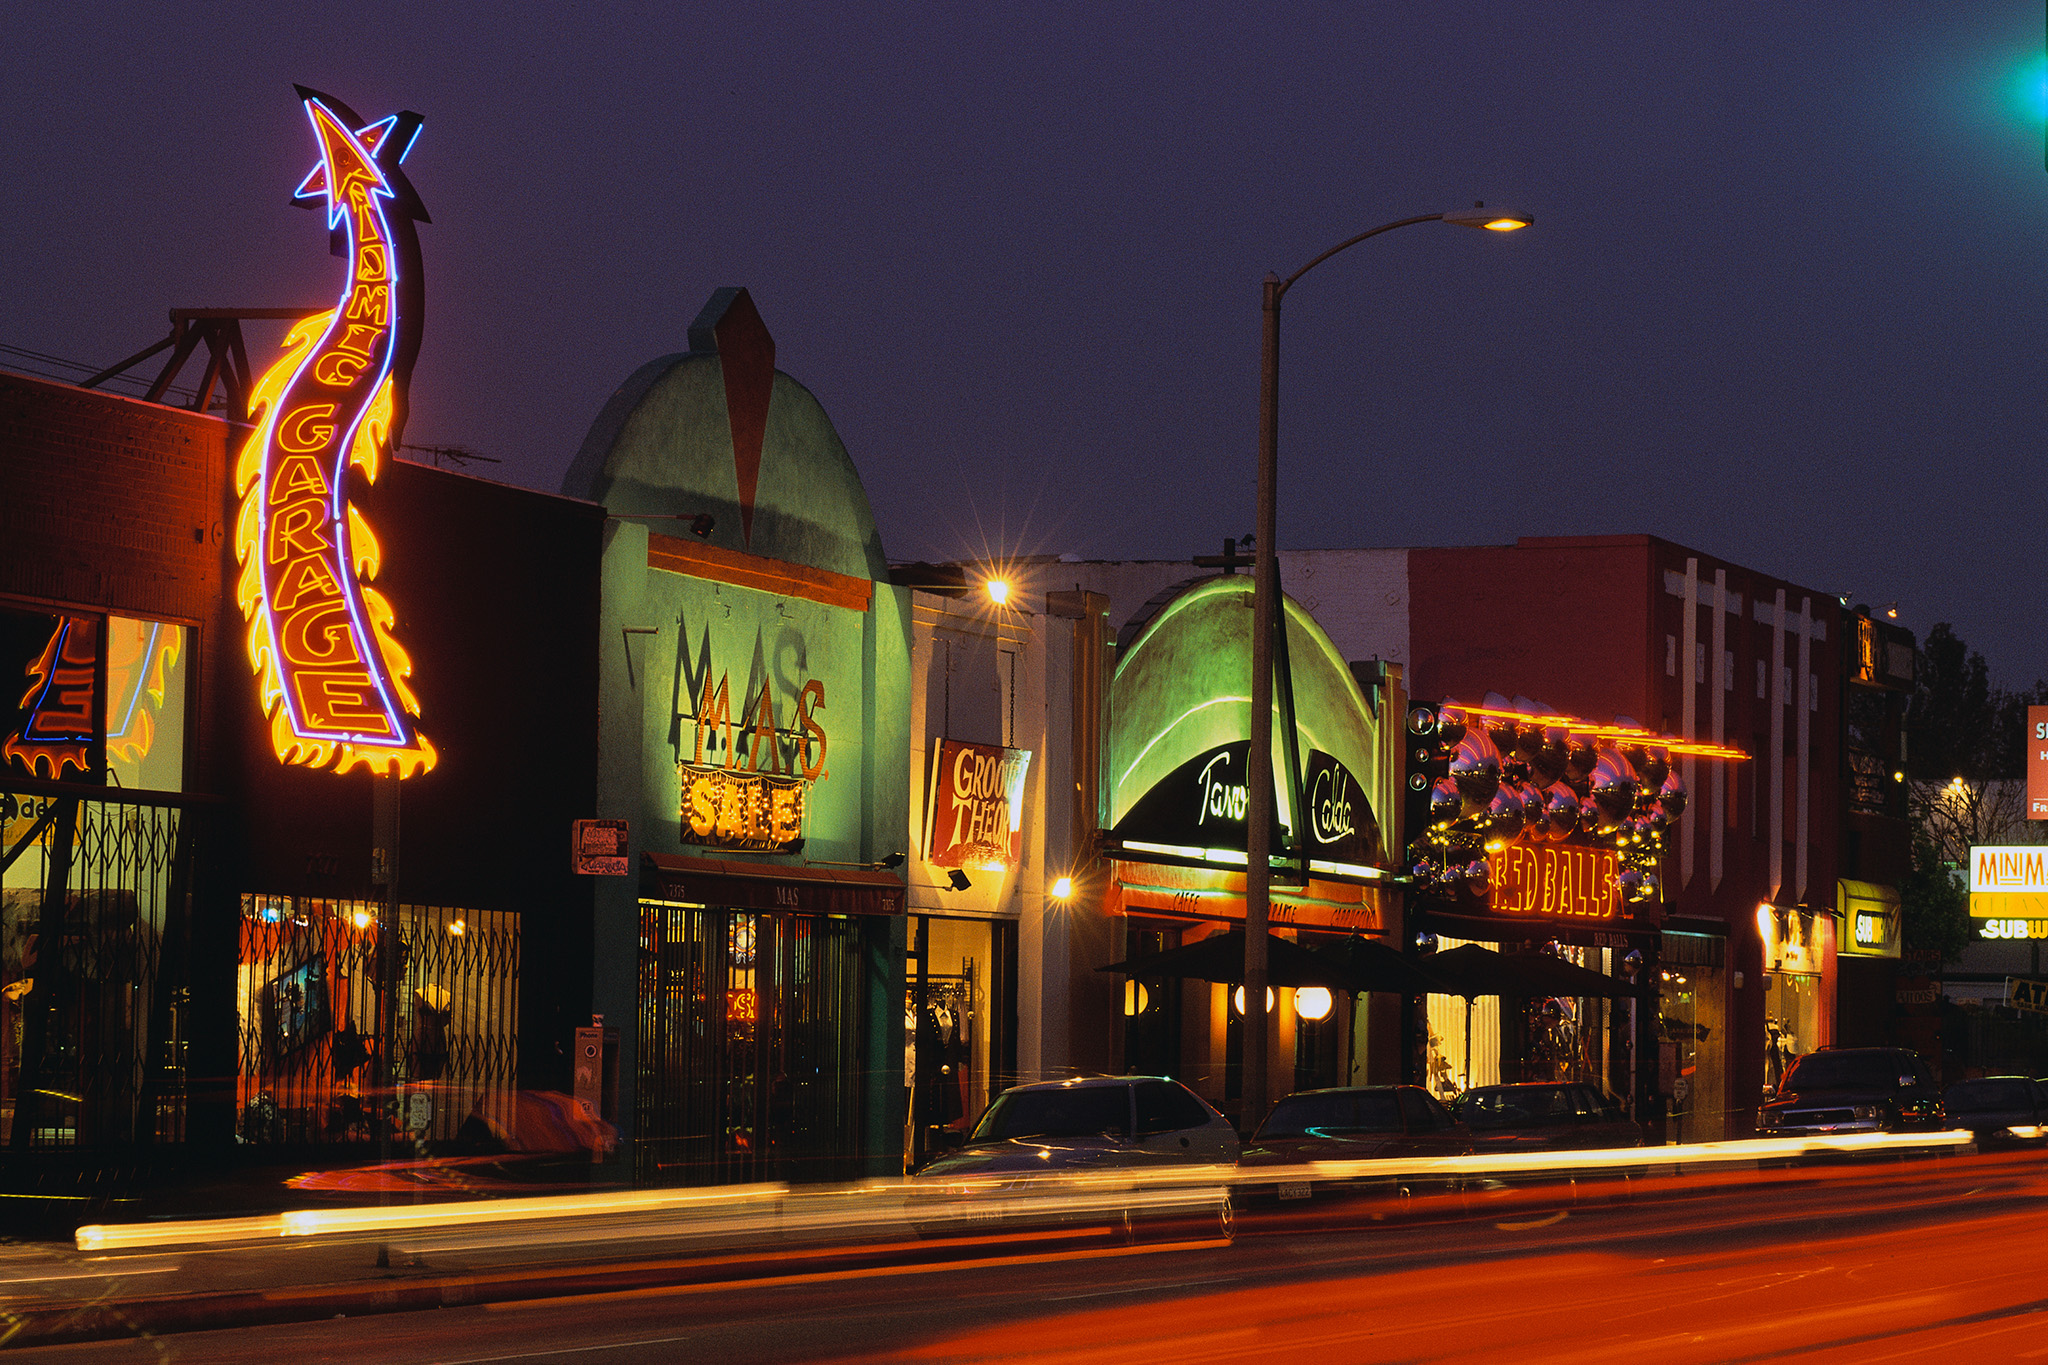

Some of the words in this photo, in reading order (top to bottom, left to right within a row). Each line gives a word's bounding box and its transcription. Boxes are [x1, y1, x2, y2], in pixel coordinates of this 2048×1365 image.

[314, 178, 389, 387] ATOMIC
[268, 402, 394, 732] GARAGE
[689, 777, 797, 843] SALE
[946, 791, 1014, 858] THEOR
[1198, 751, 1250, 825] Tavo
[1311, 763, 1355, 843] Calda
[776, 886, 800, 906] MAS
[1492, 845, 1538, 911] RED
[1541, 848, 1613, 918] BALLS
[1978, 852, 2048, 886] MINIM
[2013, 982, 2048, 1006] AT
